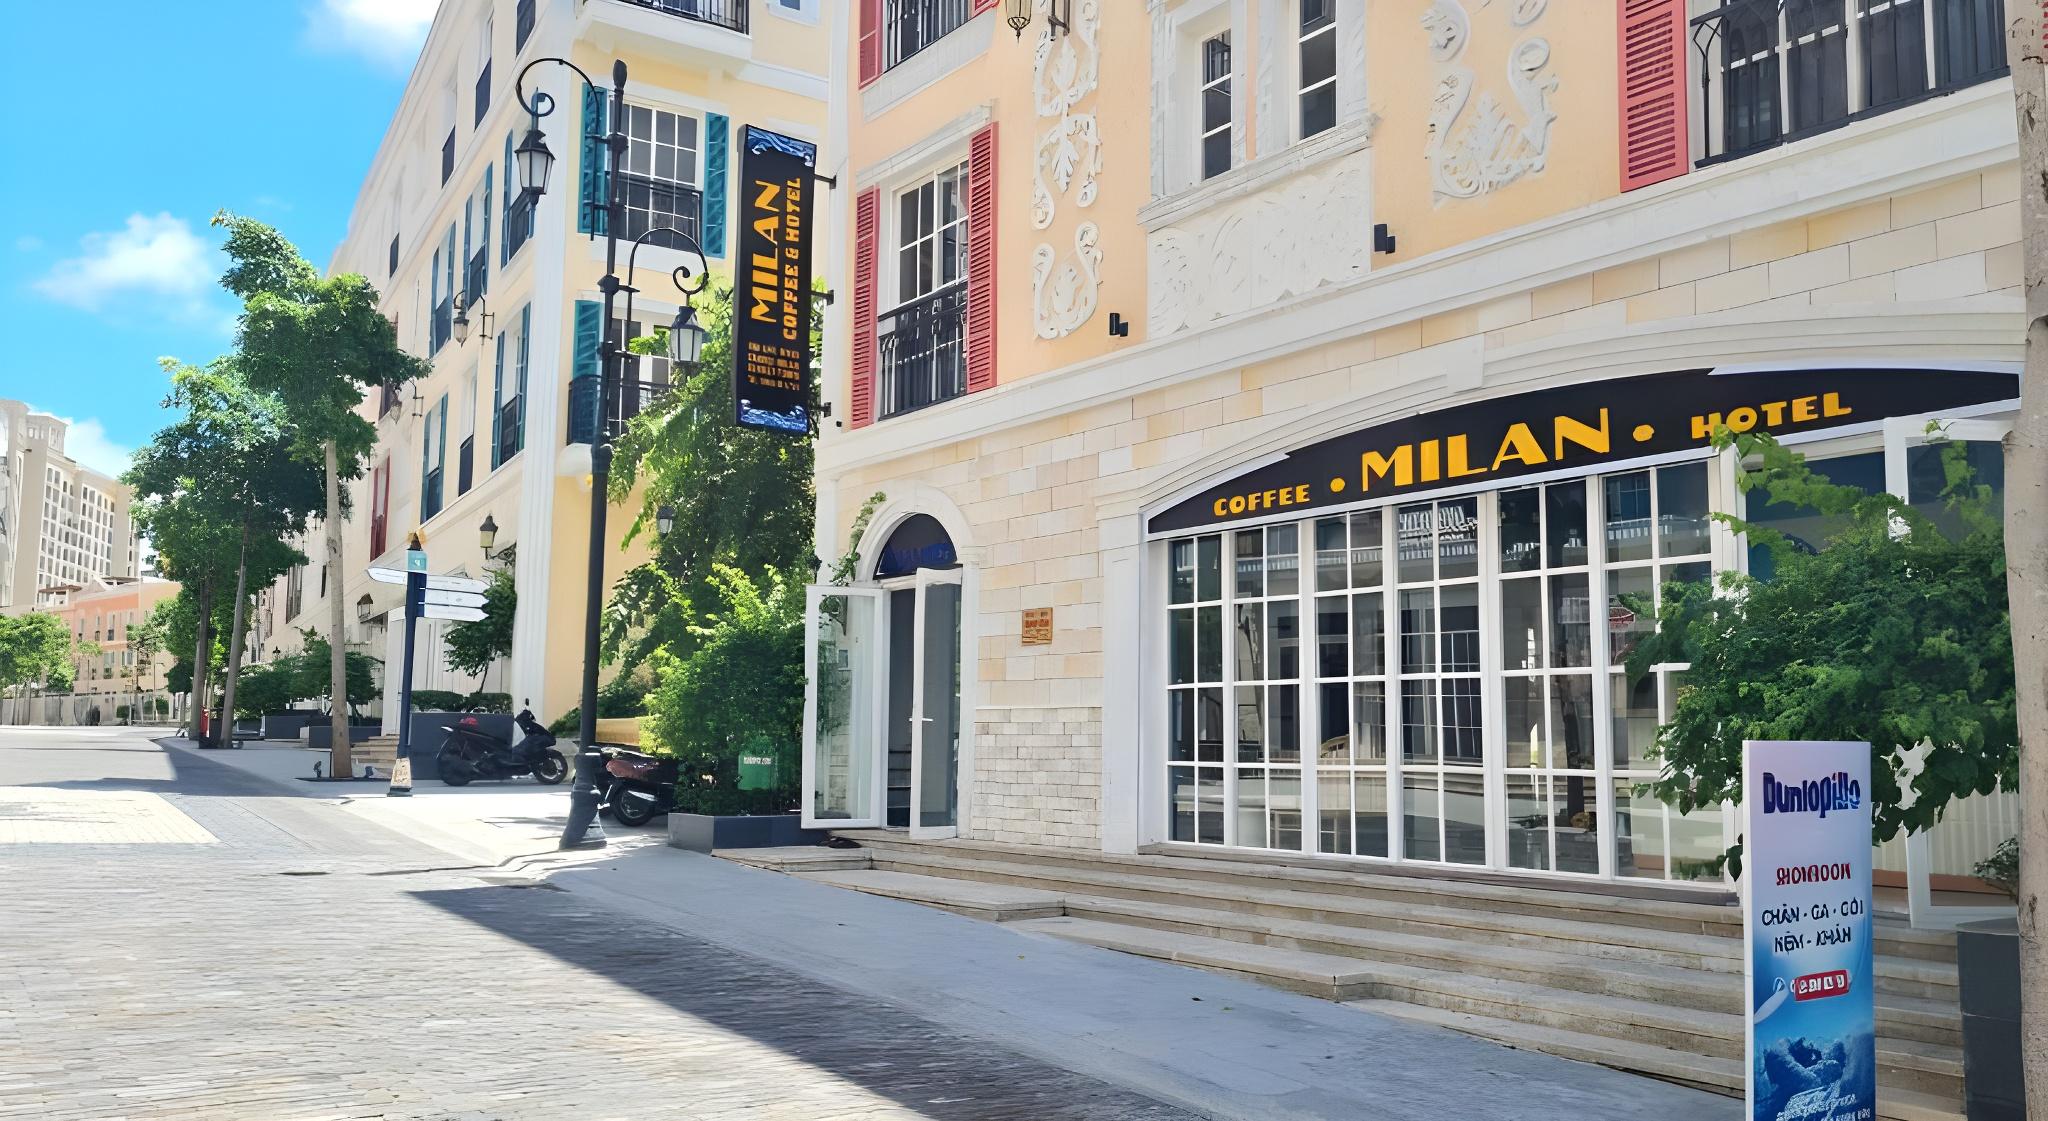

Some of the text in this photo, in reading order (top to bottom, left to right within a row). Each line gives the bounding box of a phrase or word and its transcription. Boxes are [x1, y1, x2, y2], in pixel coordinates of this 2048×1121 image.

[751, 180, 780, 323] MILAN
[783, 177, 801, 340] COFFEE & HOTEL
[1213, 392, 1852, 516] COFFEE MILAN HOTEL
